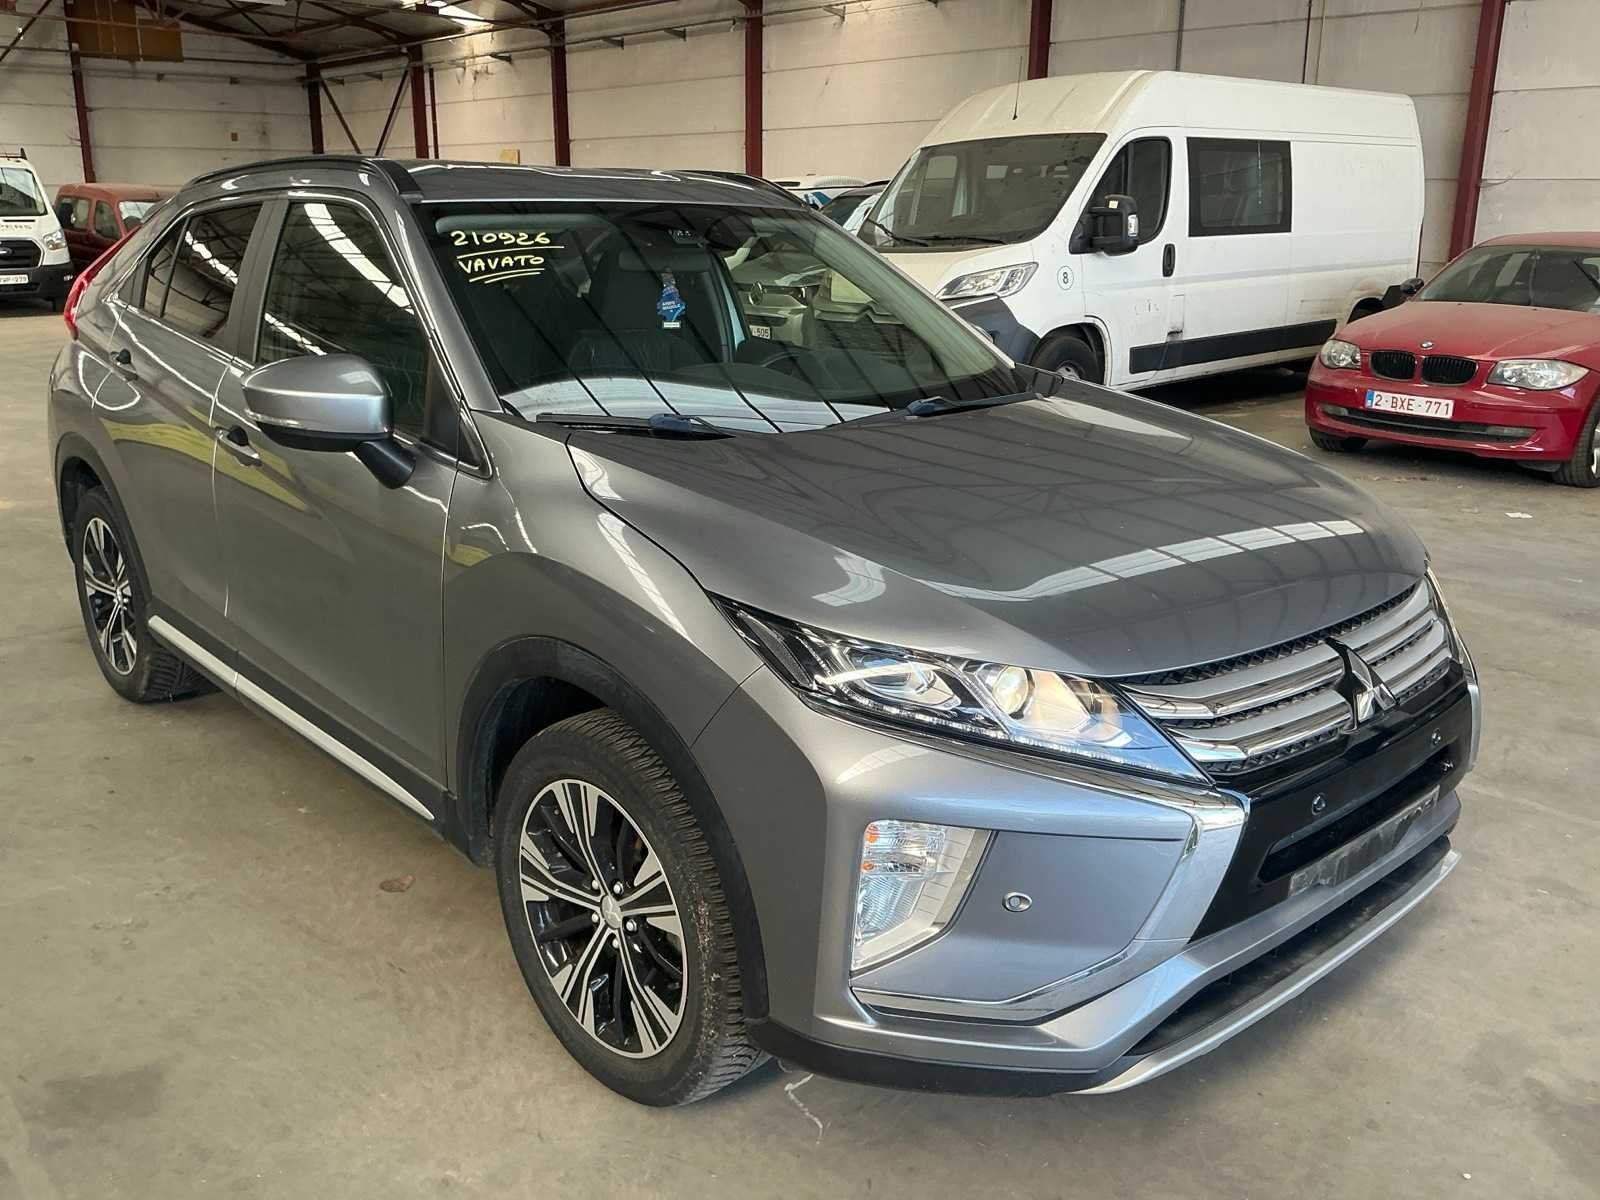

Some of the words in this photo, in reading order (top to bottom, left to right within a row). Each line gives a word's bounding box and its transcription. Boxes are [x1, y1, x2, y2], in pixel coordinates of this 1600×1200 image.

[450, 230, 551, 246] 210926
[458, 255, 545, 274] VAVATO
[1062, 271, 1069, 285] 8
